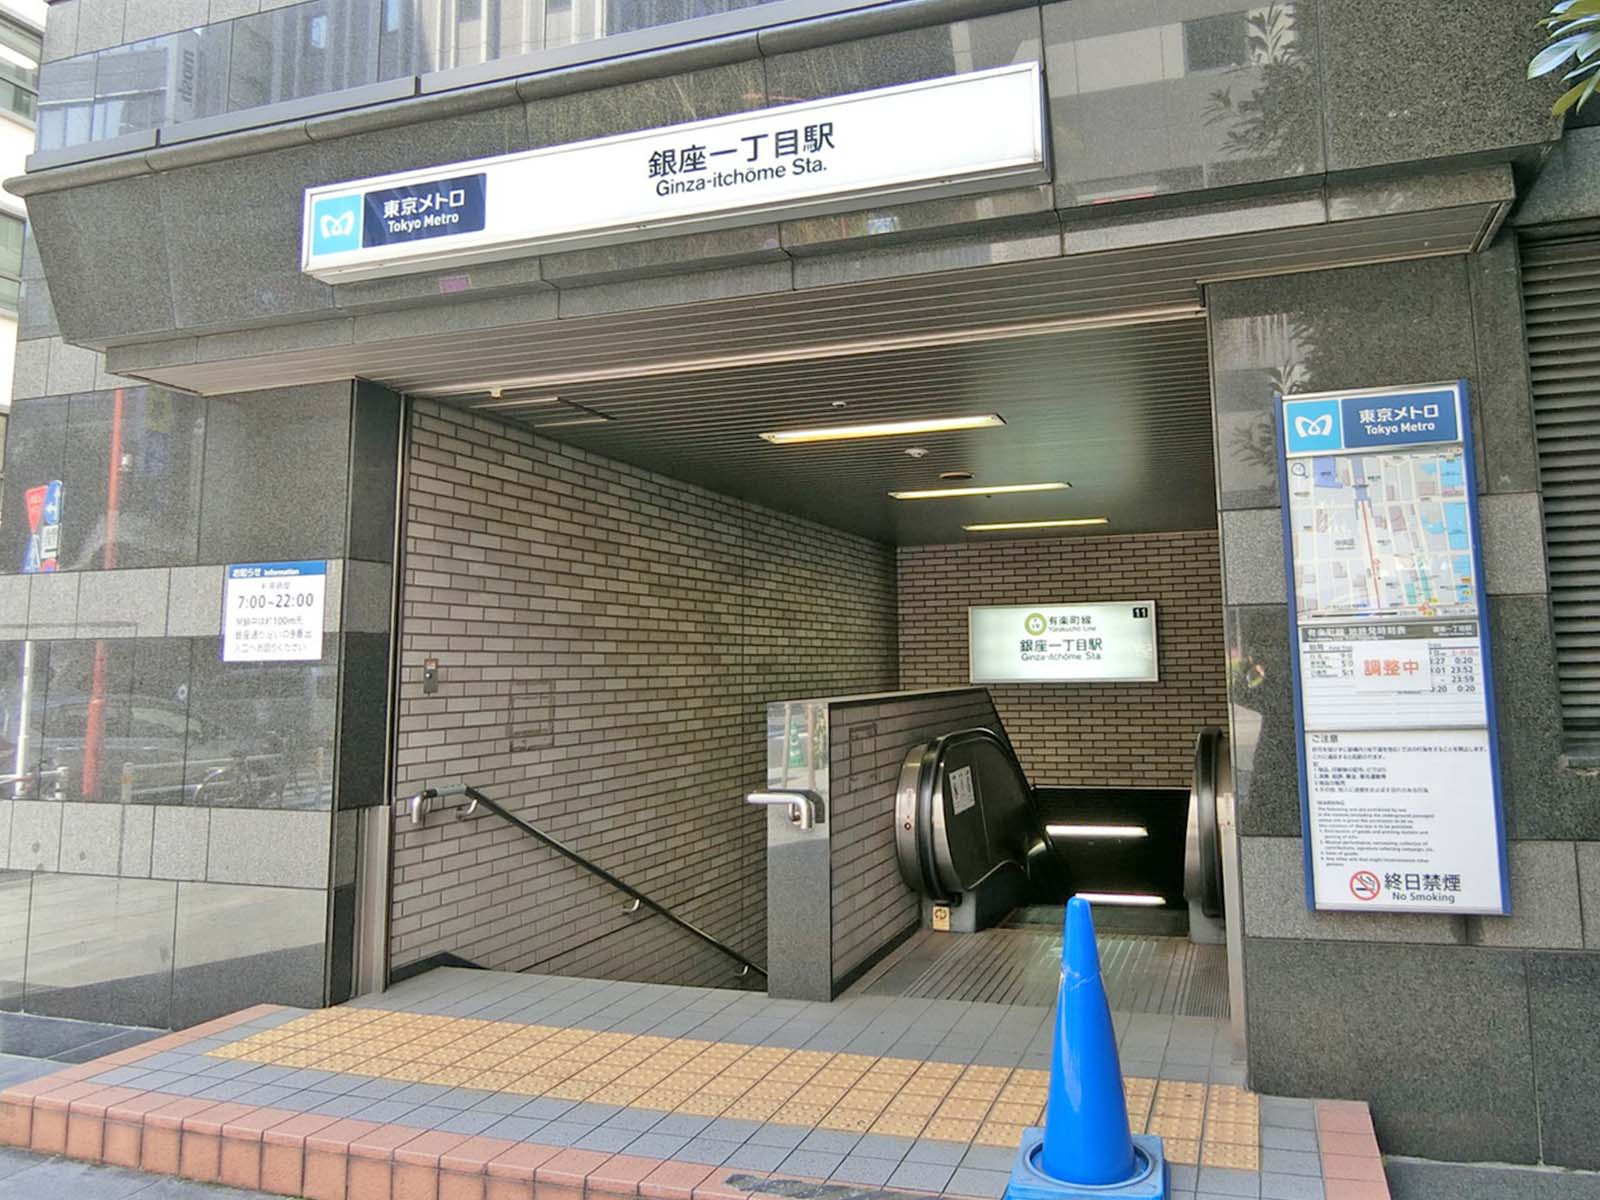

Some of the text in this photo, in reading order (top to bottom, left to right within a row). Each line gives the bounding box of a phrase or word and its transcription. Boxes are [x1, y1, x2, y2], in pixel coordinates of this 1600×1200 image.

[649, 122, 835, 178] 銀座一丁目駅
[792, 157, 827, 176] Sta.
[383, 189, 464, 218] 東京メトロ
[387, 213, 459, 233] Tokyo Metro
[1359, 404, 1439, 423] 東京メトロ
[1365, 422, 1435, 436] Tokyo Metro
[1135, 608, 1147, 618] 11
[1020, 638, 1102, 652] 銀座一丁目駅
[1363, 658, 1419, 676] 調整中
[1384, 872, 1461, 892] 終日禁煙
[1392, 891, 1456, 904] No Smoking
